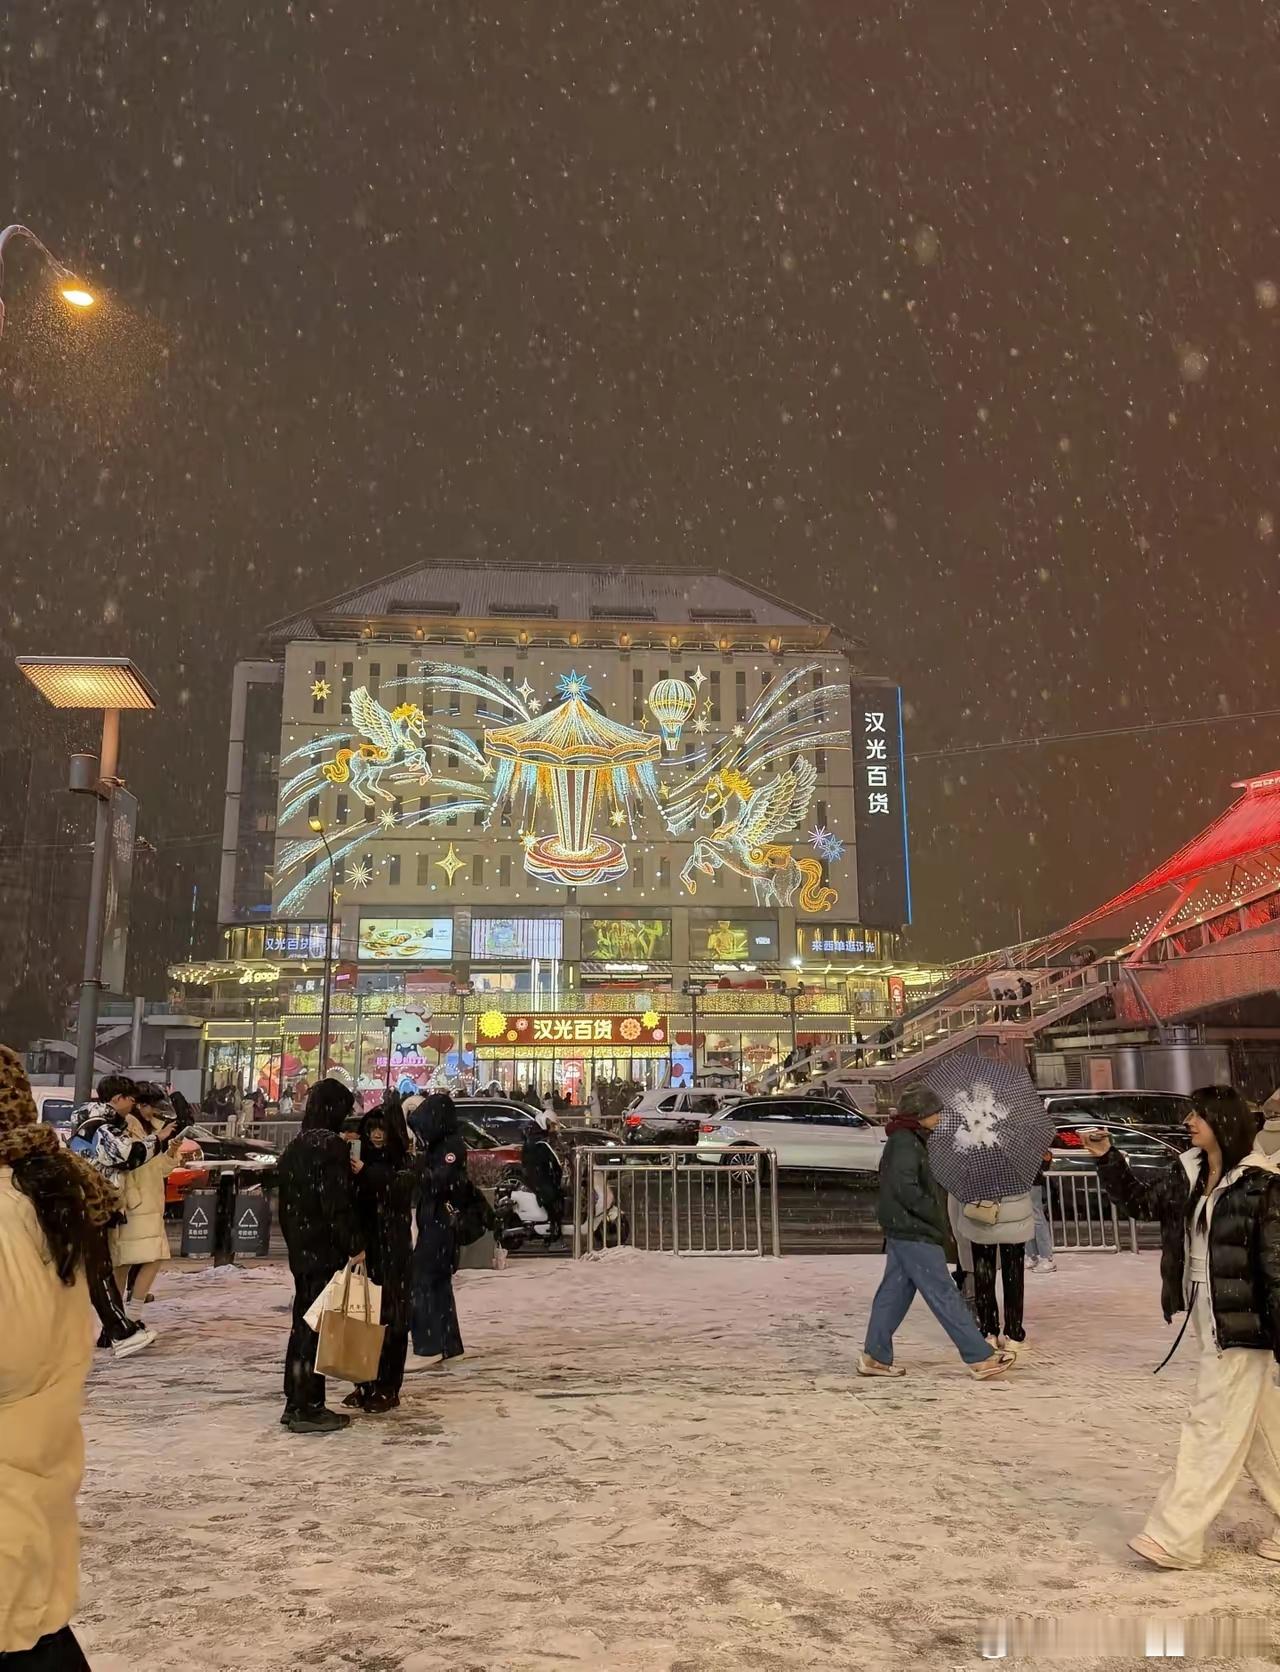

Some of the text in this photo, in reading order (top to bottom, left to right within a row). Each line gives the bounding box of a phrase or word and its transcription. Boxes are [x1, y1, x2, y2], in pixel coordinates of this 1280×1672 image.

[864, 712, 889, 814] 汉光百货
[533, 1019, 613, 1040] 汉光百货
